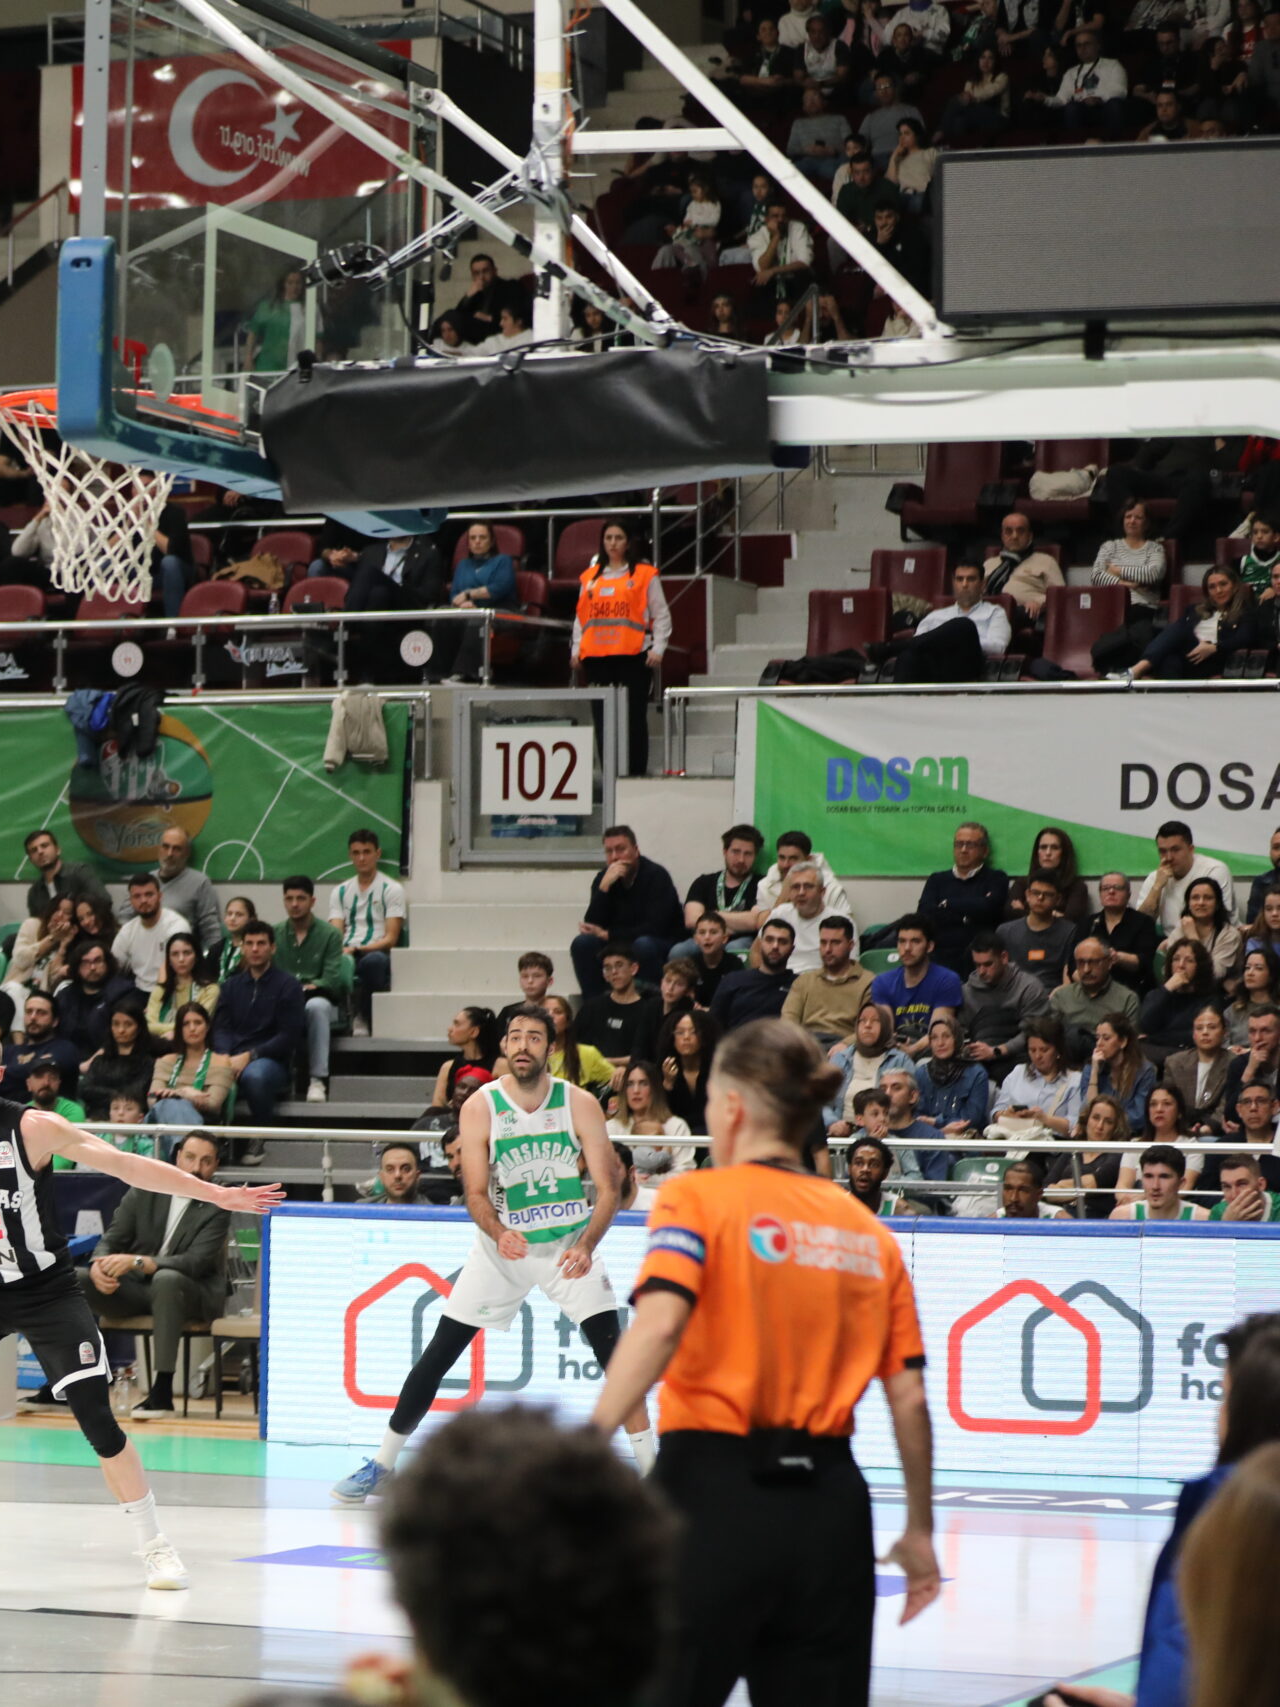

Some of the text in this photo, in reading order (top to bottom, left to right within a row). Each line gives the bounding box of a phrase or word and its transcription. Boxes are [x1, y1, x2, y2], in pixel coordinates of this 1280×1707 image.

[496, 741, 578, 801] 102
[521, 1167, 558, 1197] 14
[509, 1202, 583, 1225] BURTOM
